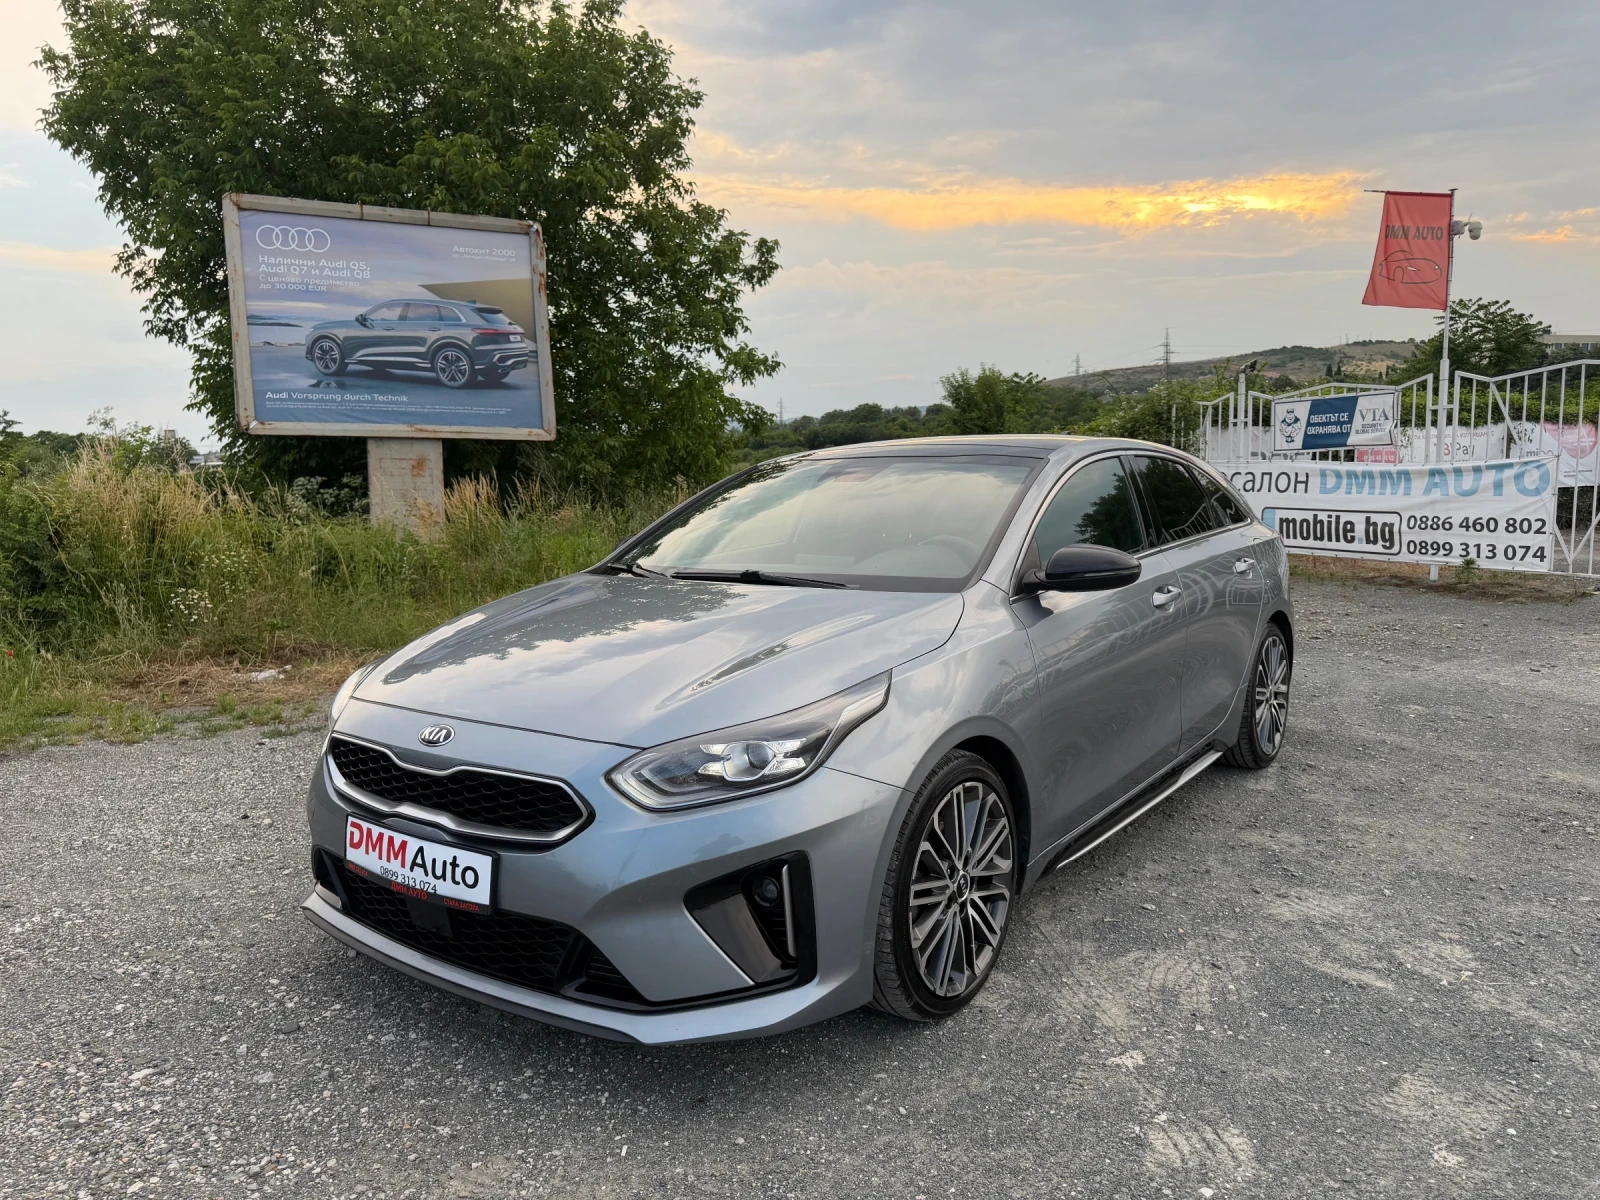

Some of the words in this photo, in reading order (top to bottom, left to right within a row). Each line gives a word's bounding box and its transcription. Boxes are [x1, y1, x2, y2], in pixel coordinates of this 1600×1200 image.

[1412, 226, 1443, 240] AUTO
[453, 246, 489, 254] Автохит
[492, 248, 516, 256] 2000
[259, 255, 315, 266] Налични
[319, 259, 346, 268] Audi
[350, 261, 371, 270] Q5,
[259, 264, 287, 273] Audi
[290, 266, 307, 275] Q7
[323, 268, 350, 277] Audi
[354, 270, 371, 279] Q8
[304, 278, 360, 287] предимство
[291, 392, 341, 401] Vorsprung
[1310, 414, 1339, 423] ОБЕКТЪТ
[1340, 413, 1348, 422] СЕ
[1359, 408, 1389, 421] VTA
[1307, 425, 1341, 434] ОХРАНЯВА
[1221, 471, 1310, 494] салон
[1319, 468, 1412, 496] DMM
[1422, 460, 1550, 498] AUTO
[1406, 515, 1453, 531] 0886
[1458, 516, 1498, 533] 460
[1504, 518, 1546, 534] 802
[1279, 514, 1395, 550] mobile.bg
[1406, 540, 1453, 556] 0899
[1459, 542, 1497, 559] 313
[1504, 544, 1546, 562] 074
[420, 727, 448, 742] KIA
[349, 820, 408, 869] DMM
[410, 846, 479, 889] Auto
[380, 866, 398, 880] 0899
[400, 874, 416, 888] 313
[420, 880, 438, 894] 074
[409, 887, 427, 900] АУТО
[444, 898, 459, 907] СТАРА
[459, 902, 479, 911] ЗАГОРА
